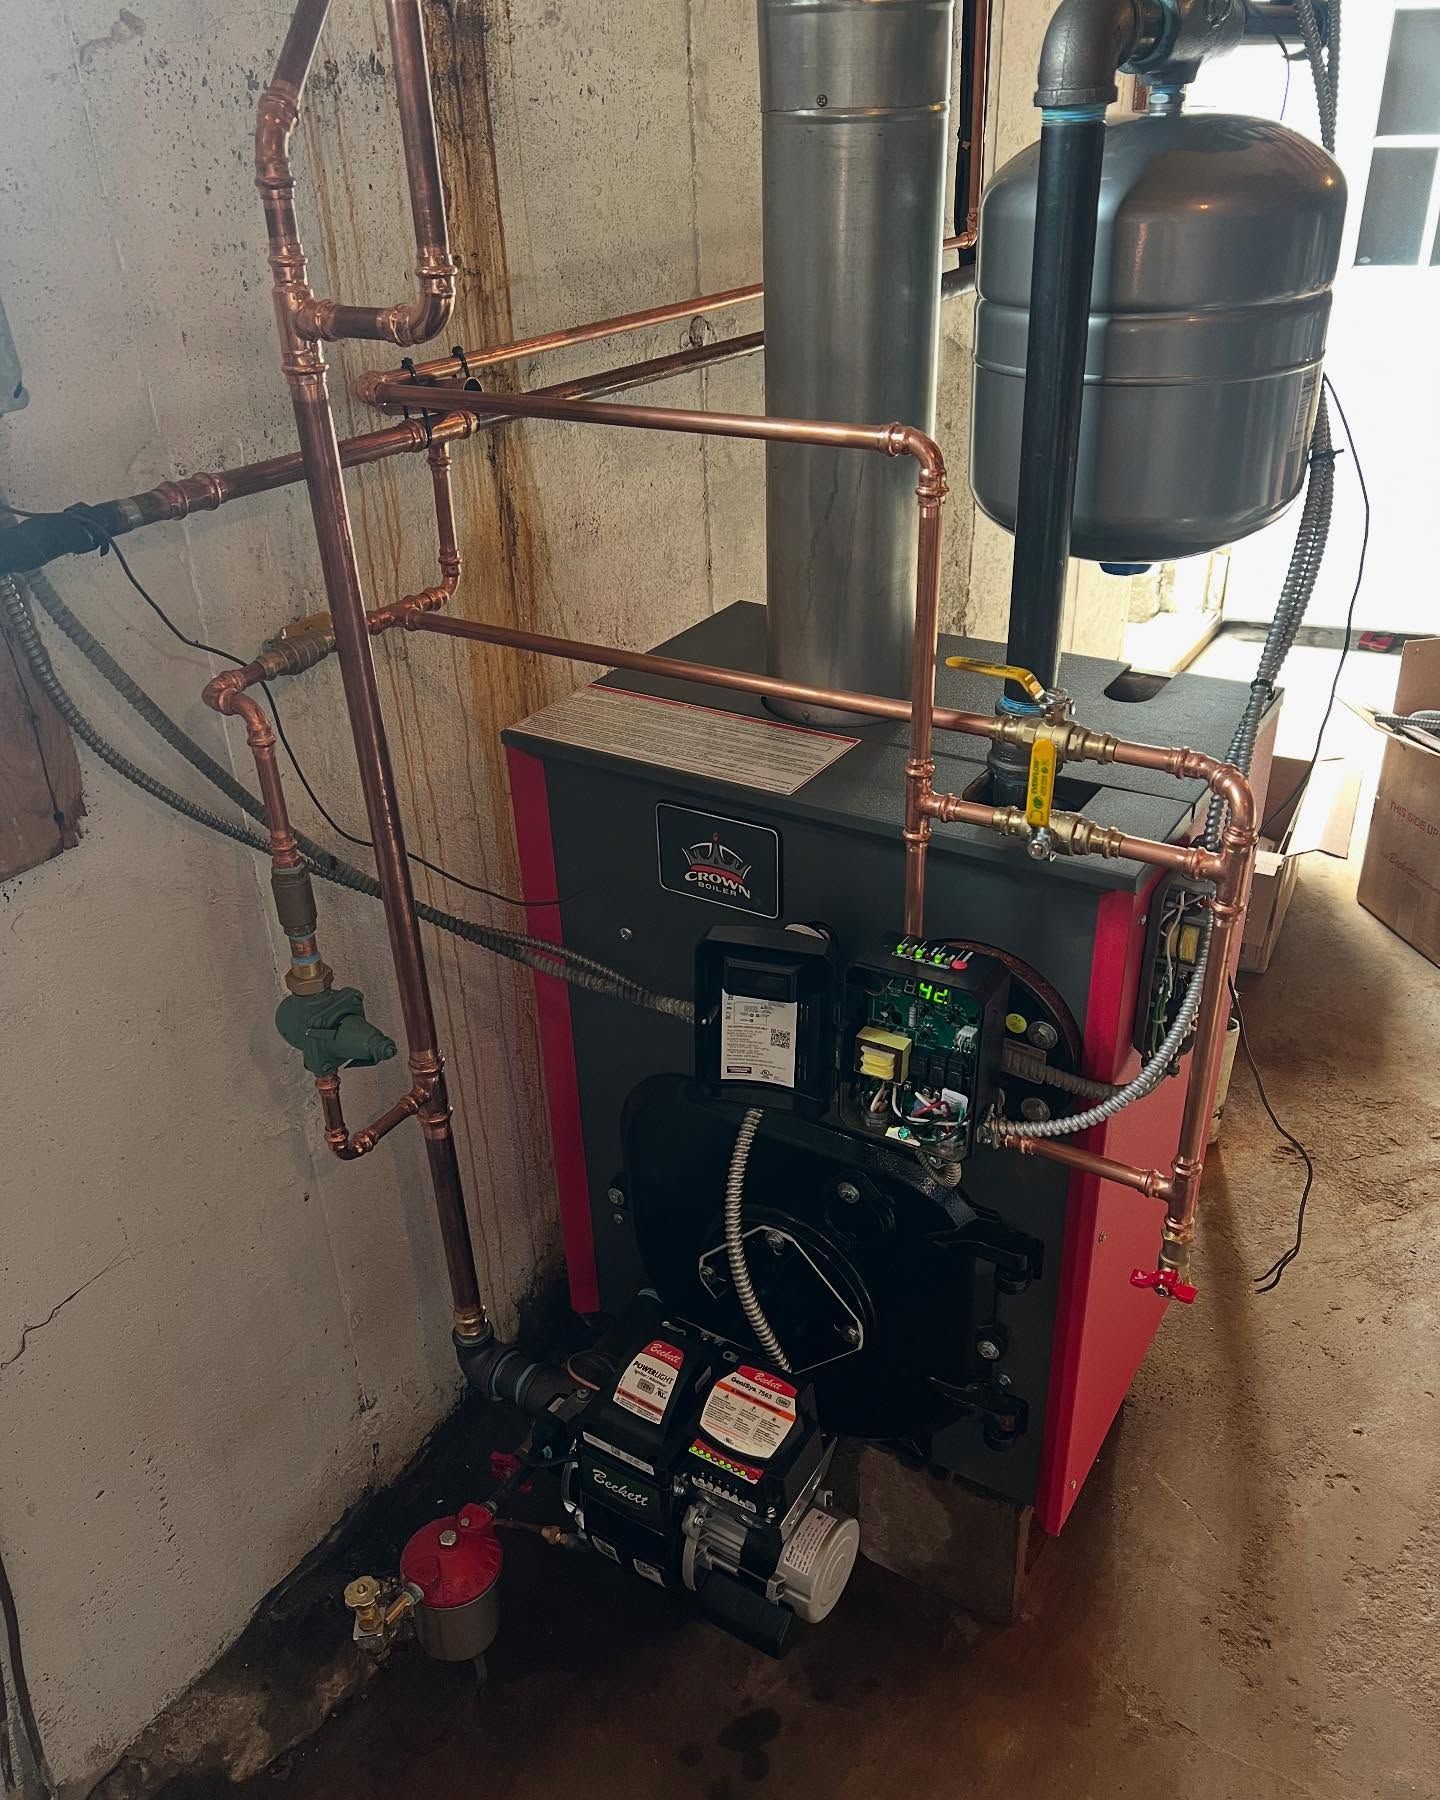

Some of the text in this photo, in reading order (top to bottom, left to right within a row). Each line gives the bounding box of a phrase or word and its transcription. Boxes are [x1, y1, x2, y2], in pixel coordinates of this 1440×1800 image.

[1391, 801, 1439, 838] THIS SIDE UP
[684, 871, 751, 899] CROWN
[698, 881, 737, 897] BOILER
[650, 1343, 681, 1363] Beckett
[633, 1361, 675, 1384] POWERLIGHT
[754, 1372, 783, 1390] Beckett
[758, 1389, 773, 1400] 7565
[592, 1468, 649, 1506] Beckett
